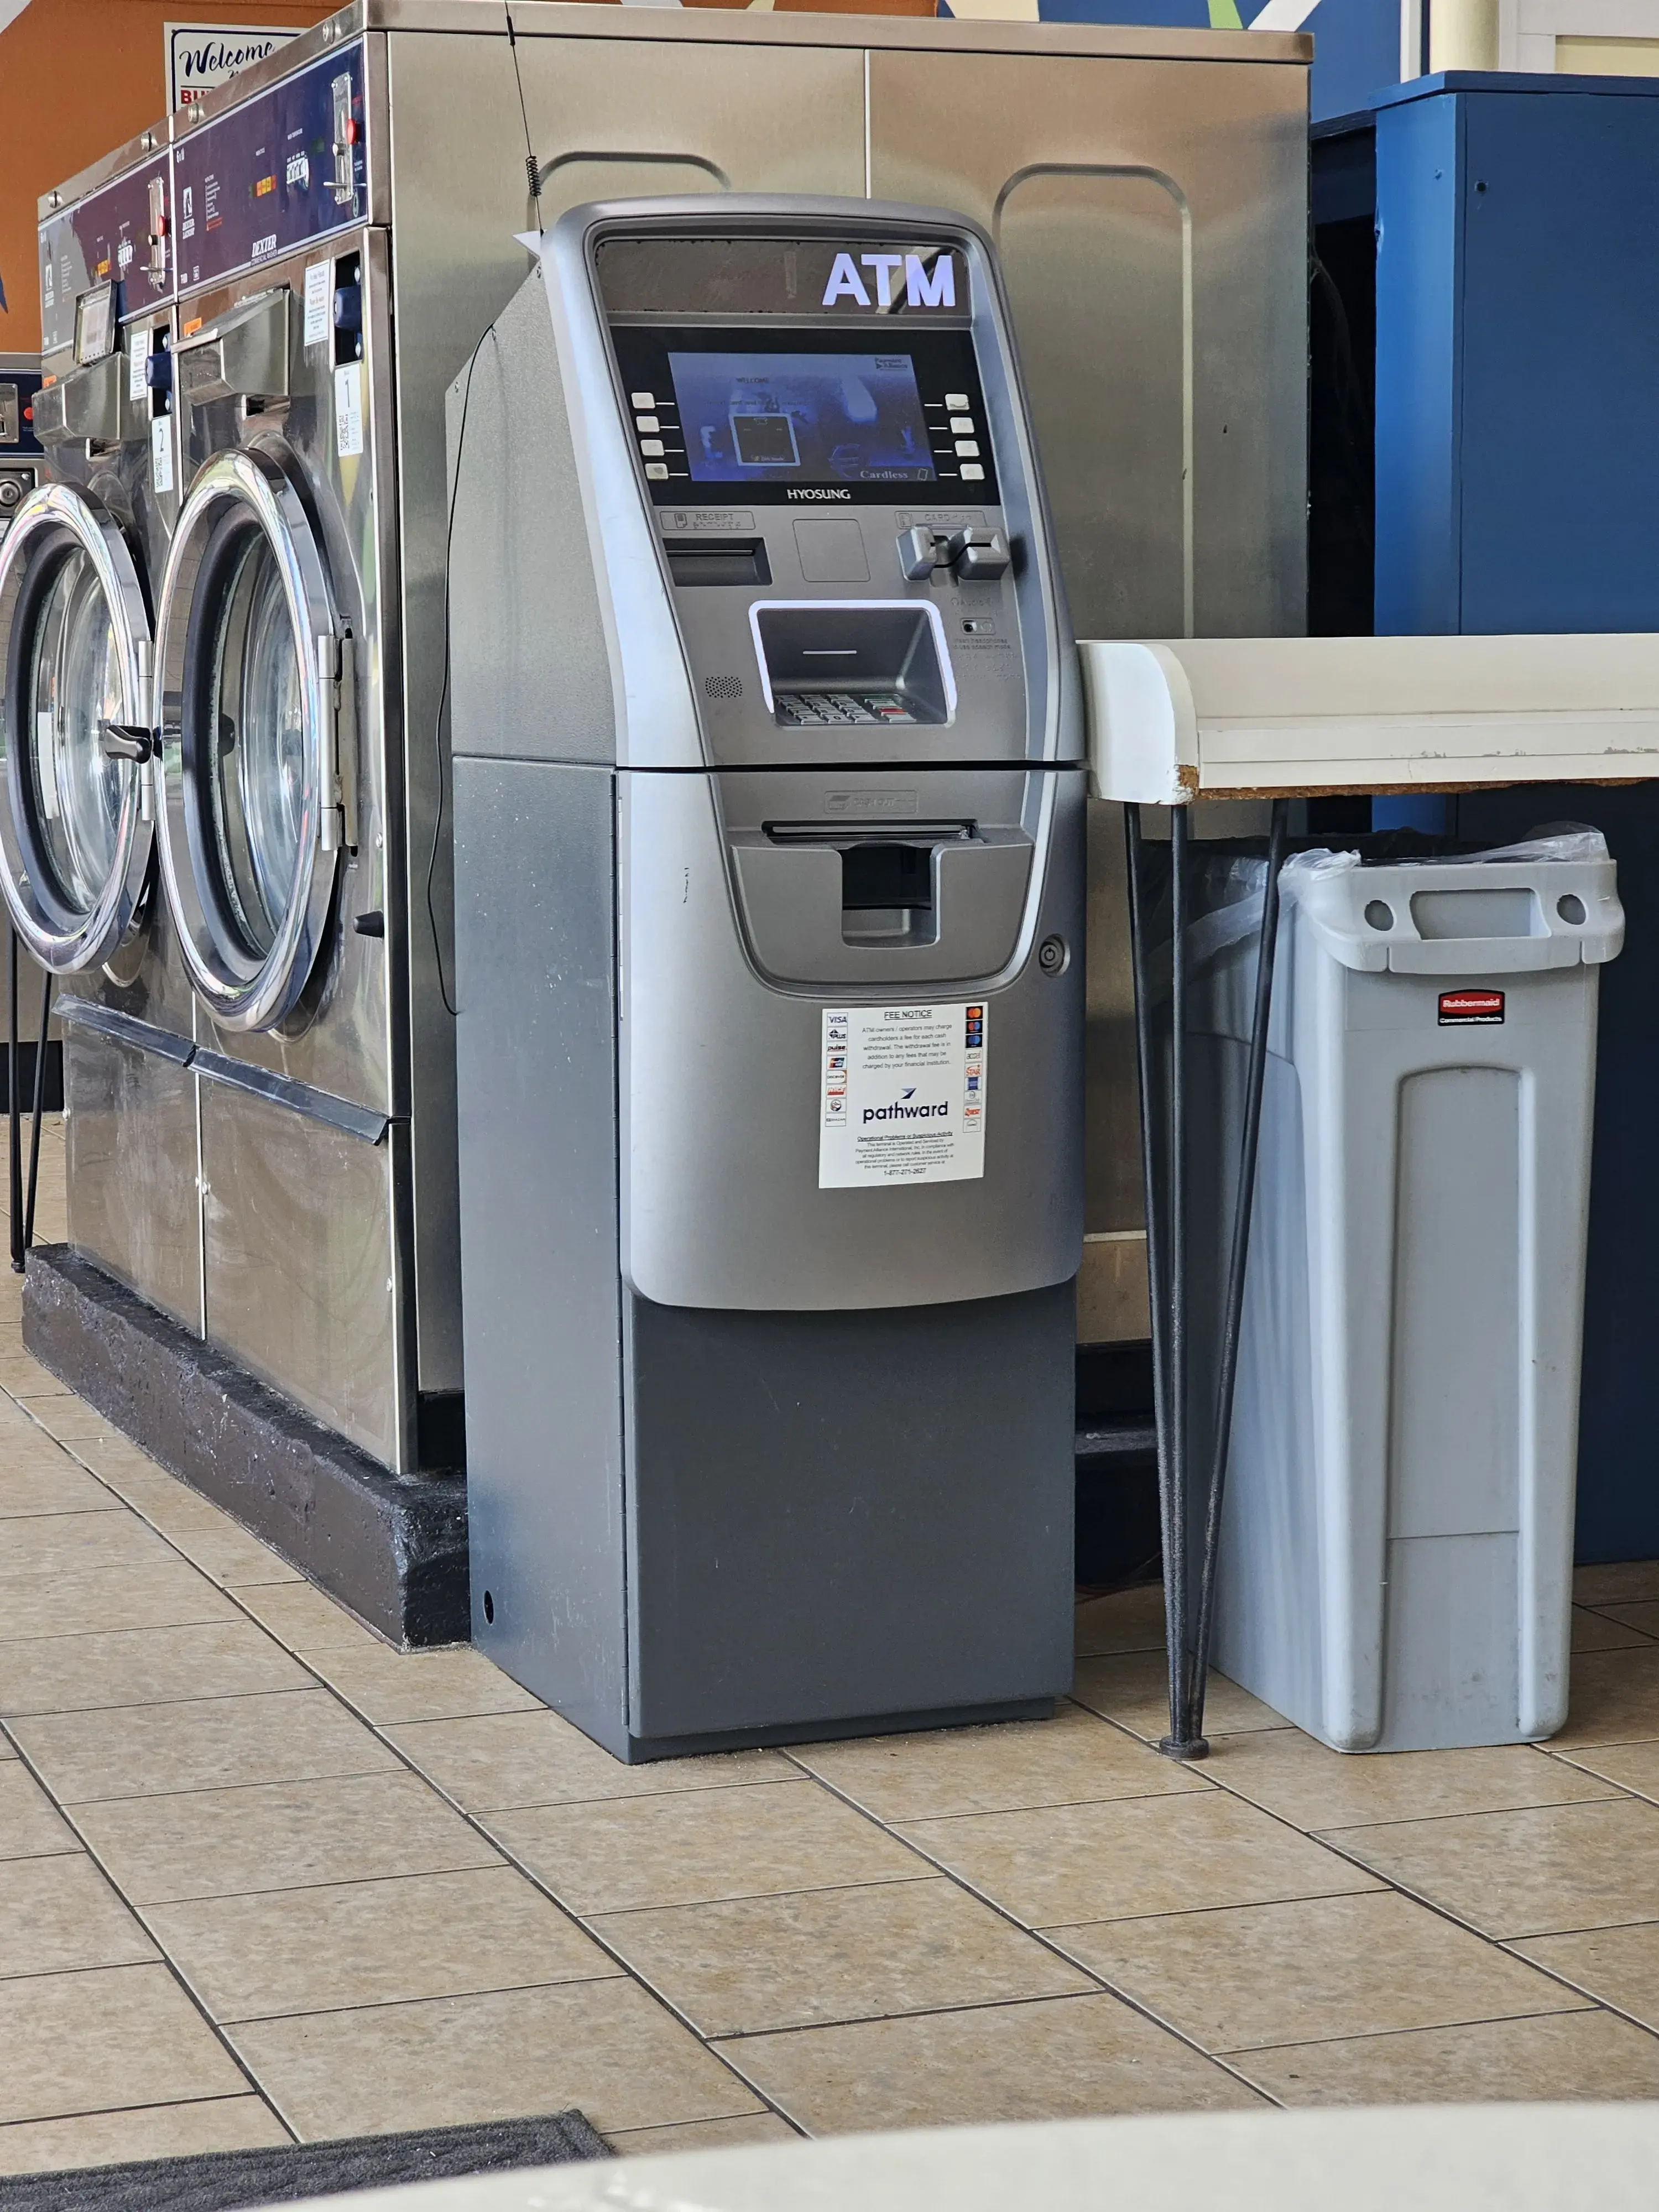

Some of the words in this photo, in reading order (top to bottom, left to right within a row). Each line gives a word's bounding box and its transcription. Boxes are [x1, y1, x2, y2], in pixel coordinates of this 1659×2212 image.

[252, 234, 276, 258] DEXTER
[822, 253, 956, 306] ATM
[345, 379, 350, 408] 1
[159, 428, 164, 452] 2
[860, 470, 909, 479] Cardless
[787, 489, 851, 499] HYOSUNG
[902, 1009, 932, 1018] NOTICE
[1442, 999, 1500, 1007] Rubbermaid
[863, 1101, 948, 1124] pathward
